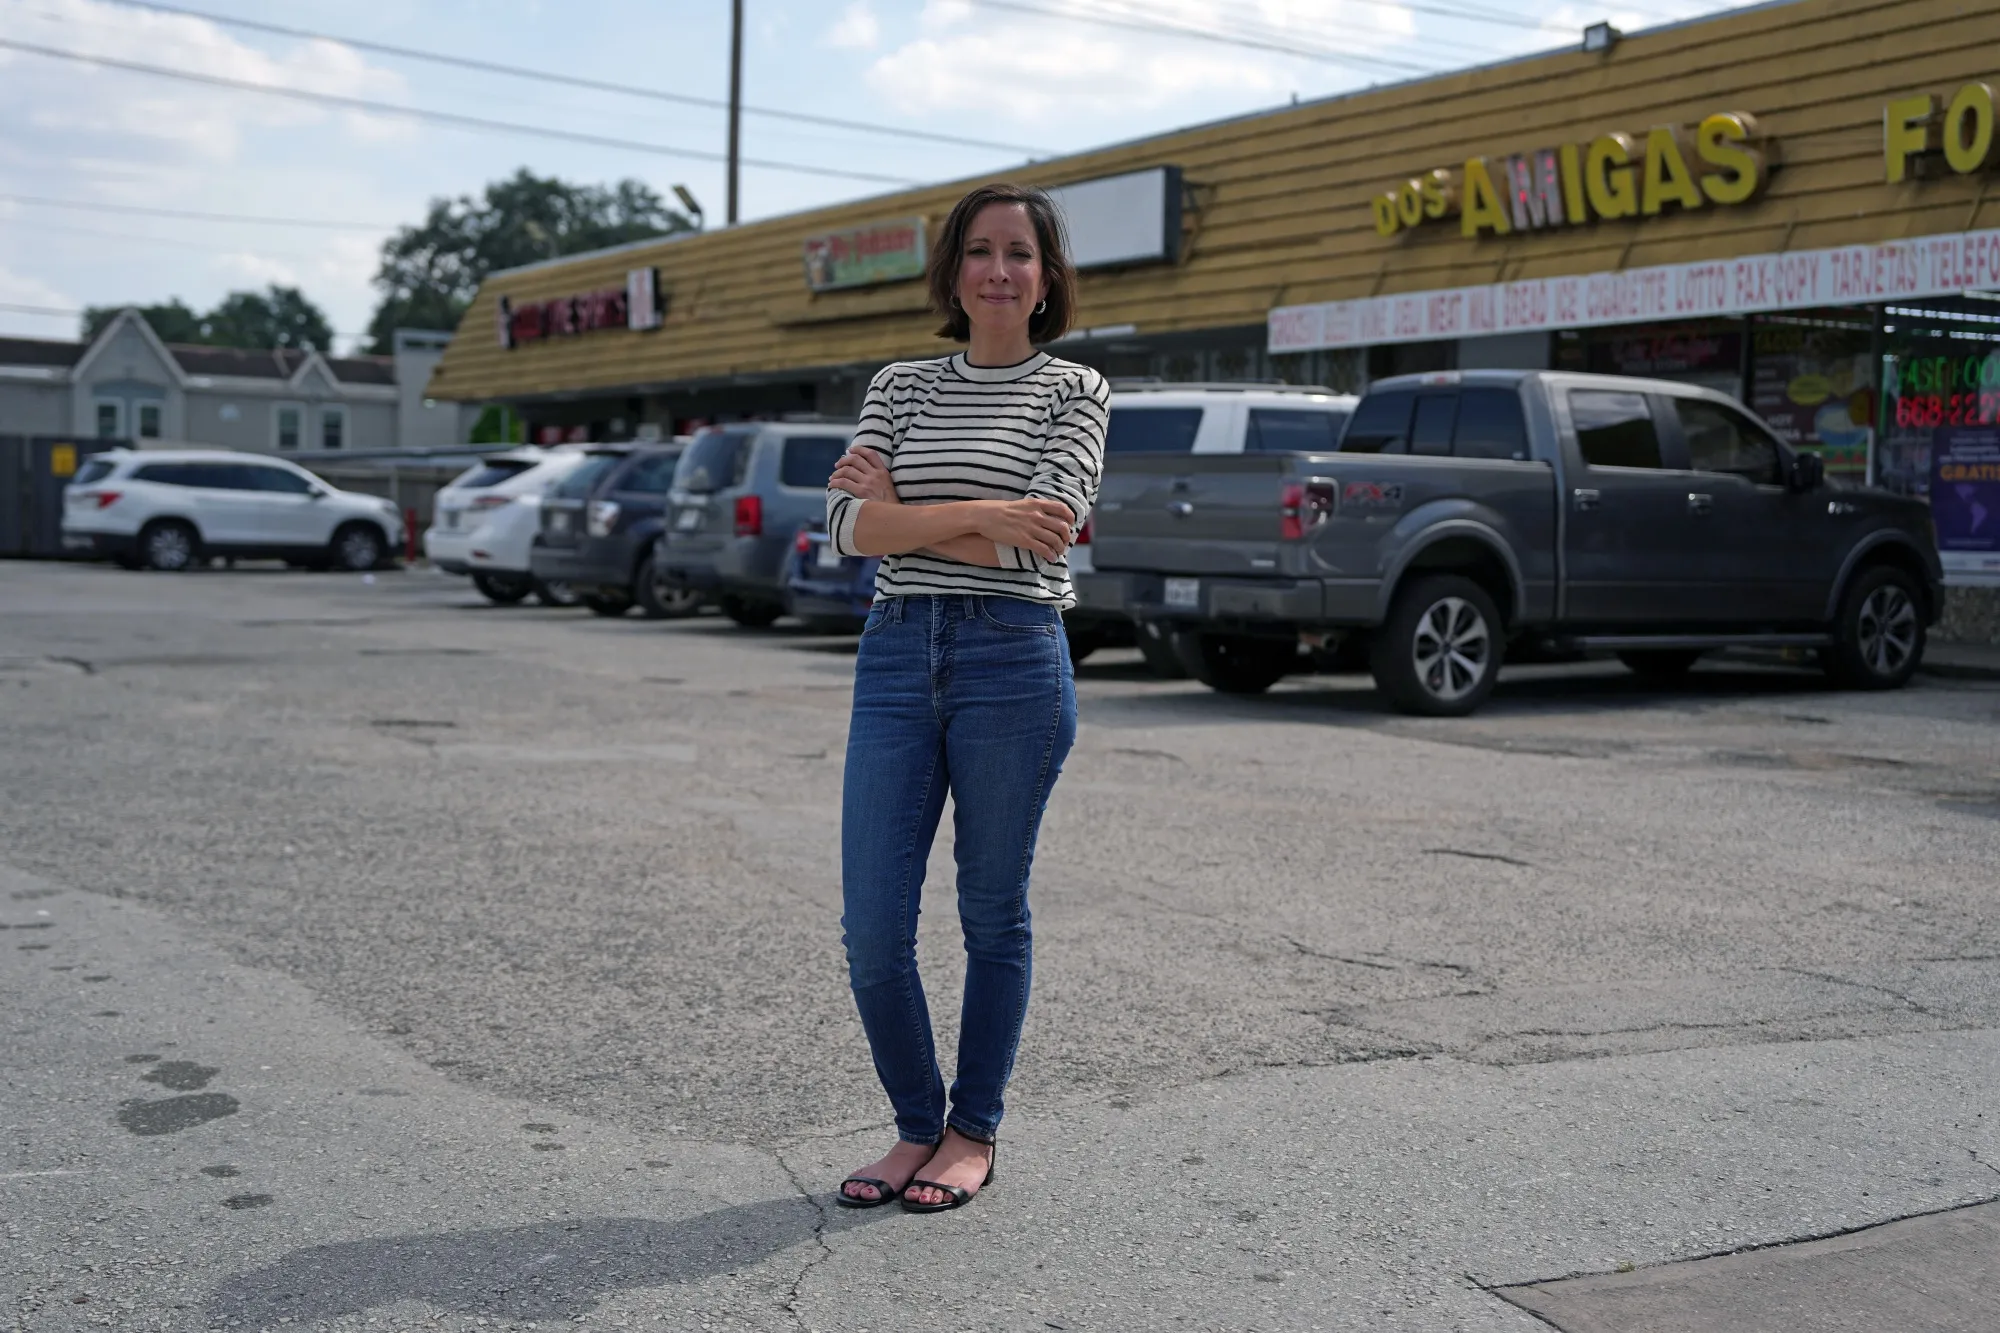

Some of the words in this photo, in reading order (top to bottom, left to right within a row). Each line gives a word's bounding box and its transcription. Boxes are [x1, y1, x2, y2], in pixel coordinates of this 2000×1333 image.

[1373, 170, 1449, 237] DOS
[1461, 112, 1759, 237] AMIGAS
[1884, 82, 1993, 184] FO
[1676, 264, 1726, 312] LOTTO
[1735, 254, 1820, 307] FAX-COPY
[1831, 244, 1919, 298] TARJETAS
[1951, 355, 2000, 389] FOO
[1344, 482, 1402, 504] FX4
